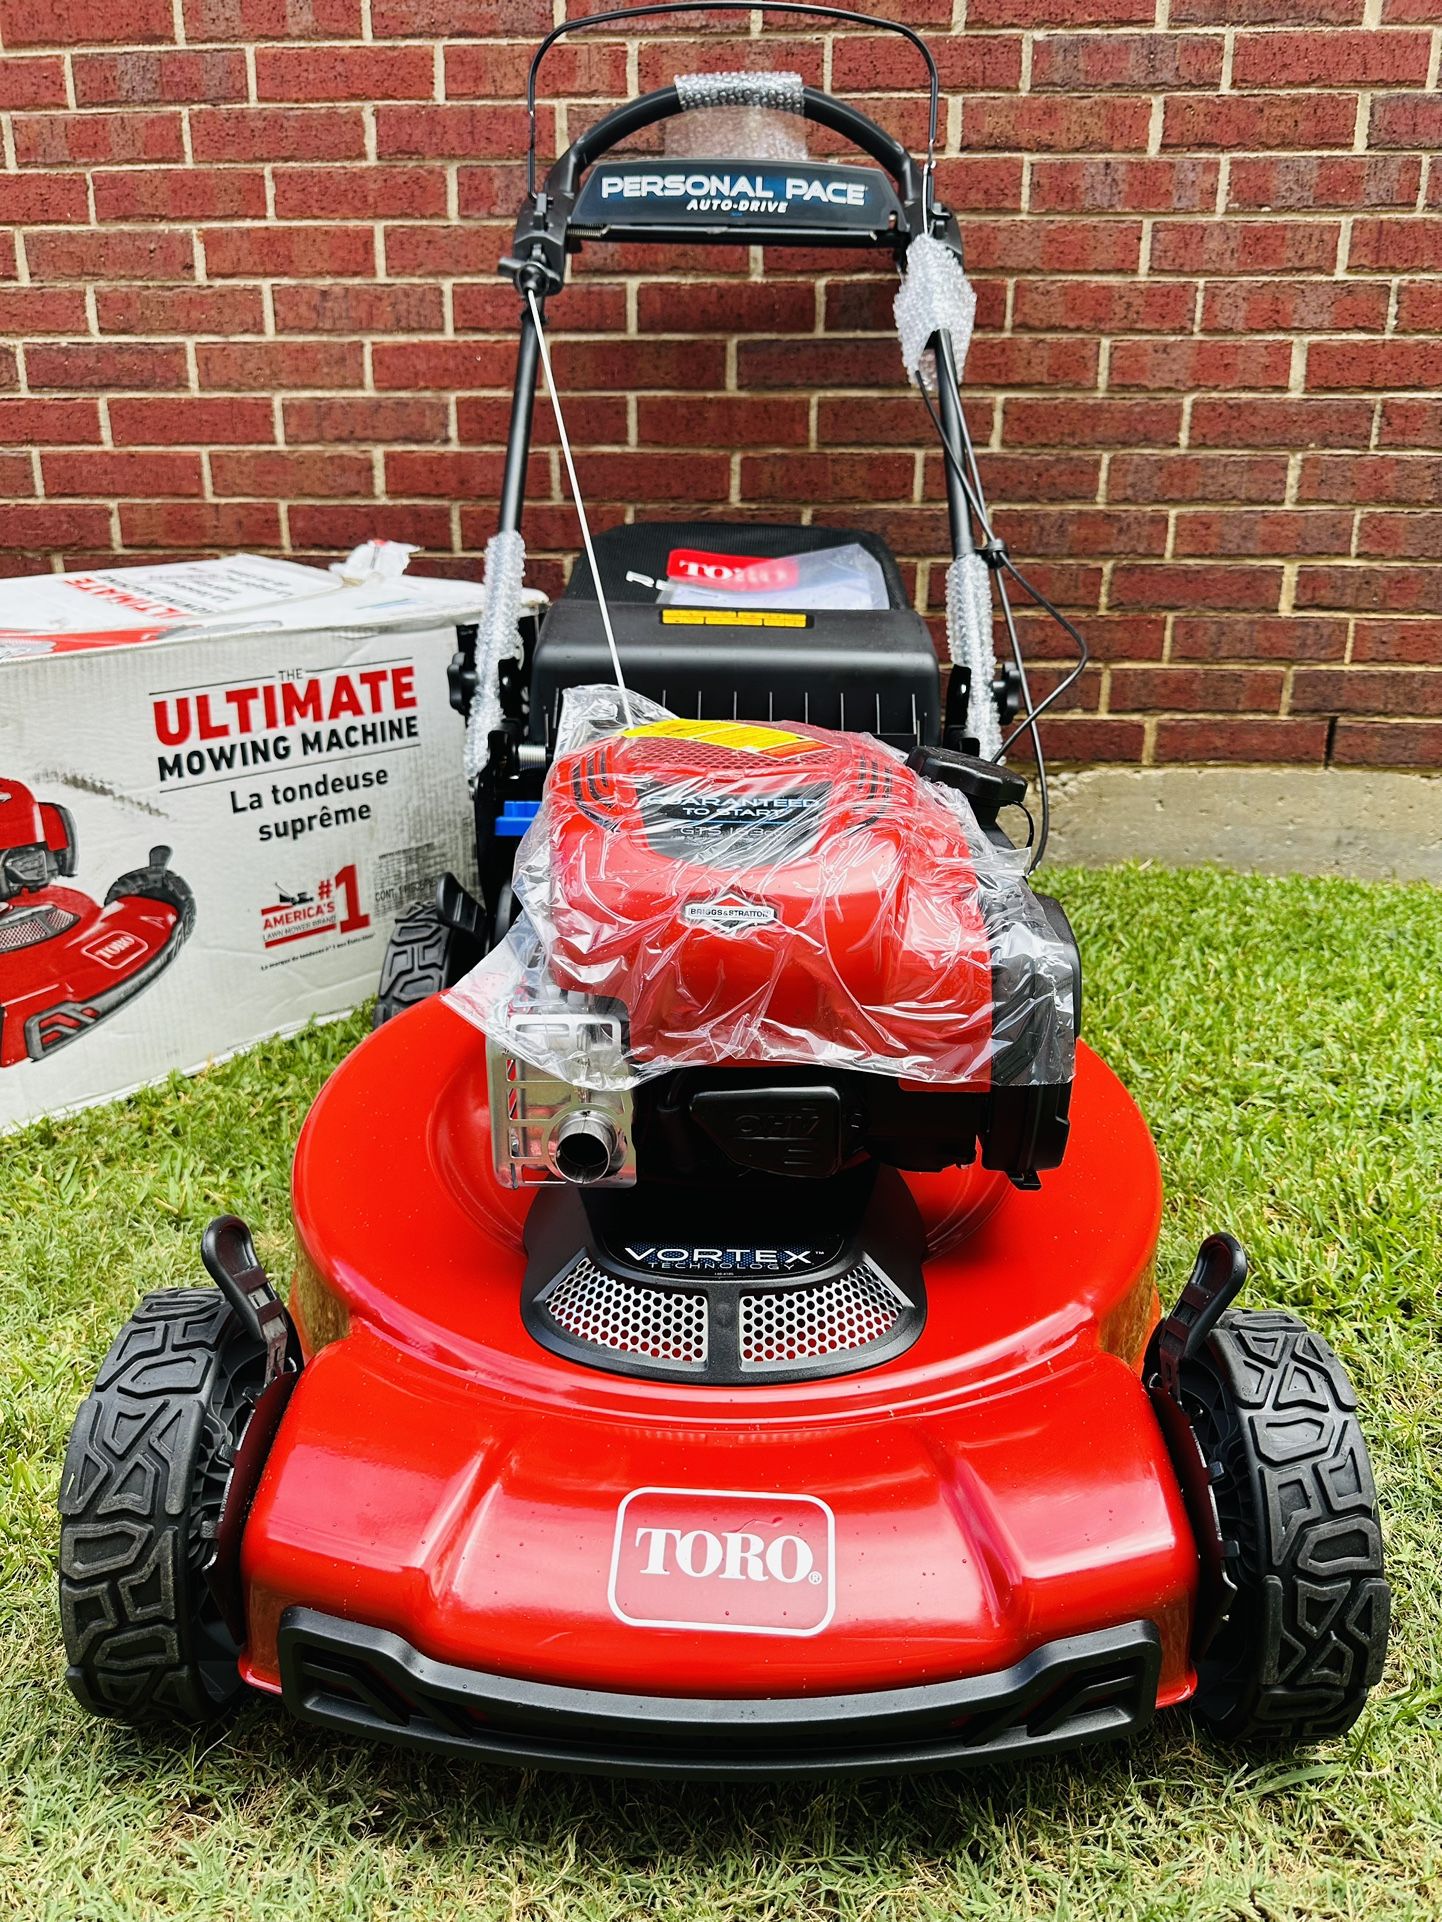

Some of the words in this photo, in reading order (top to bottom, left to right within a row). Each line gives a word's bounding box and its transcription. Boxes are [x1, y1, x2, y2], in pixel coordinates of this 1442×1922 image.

[601, 174, 774, 199] PERSONAL
[785, 177, 867, 206] PACE
[686, 199, 789, 214] AUTO-DRIVE
[278, 668, 304, 682] THE
[153, 665, 418, 747] ULTIMATE
[157, 735, 292, 782] MOWING
[301, 715, 419, 756] MACHINE
[230, 790, 263, 814] La
[271, 768, 389, 806] tondeuse
[258, 803, 372, 842] suprême
[682, 807, 710, 816] TO
[716, 807, 782, 817] START
[680, 826, 722, 836] GTS
[263, 901, 336, 931] AMERICA'S
[263, 929, 284, 941] LAWN
[648, 1262, 796, 1271] TECHNOLOGY
